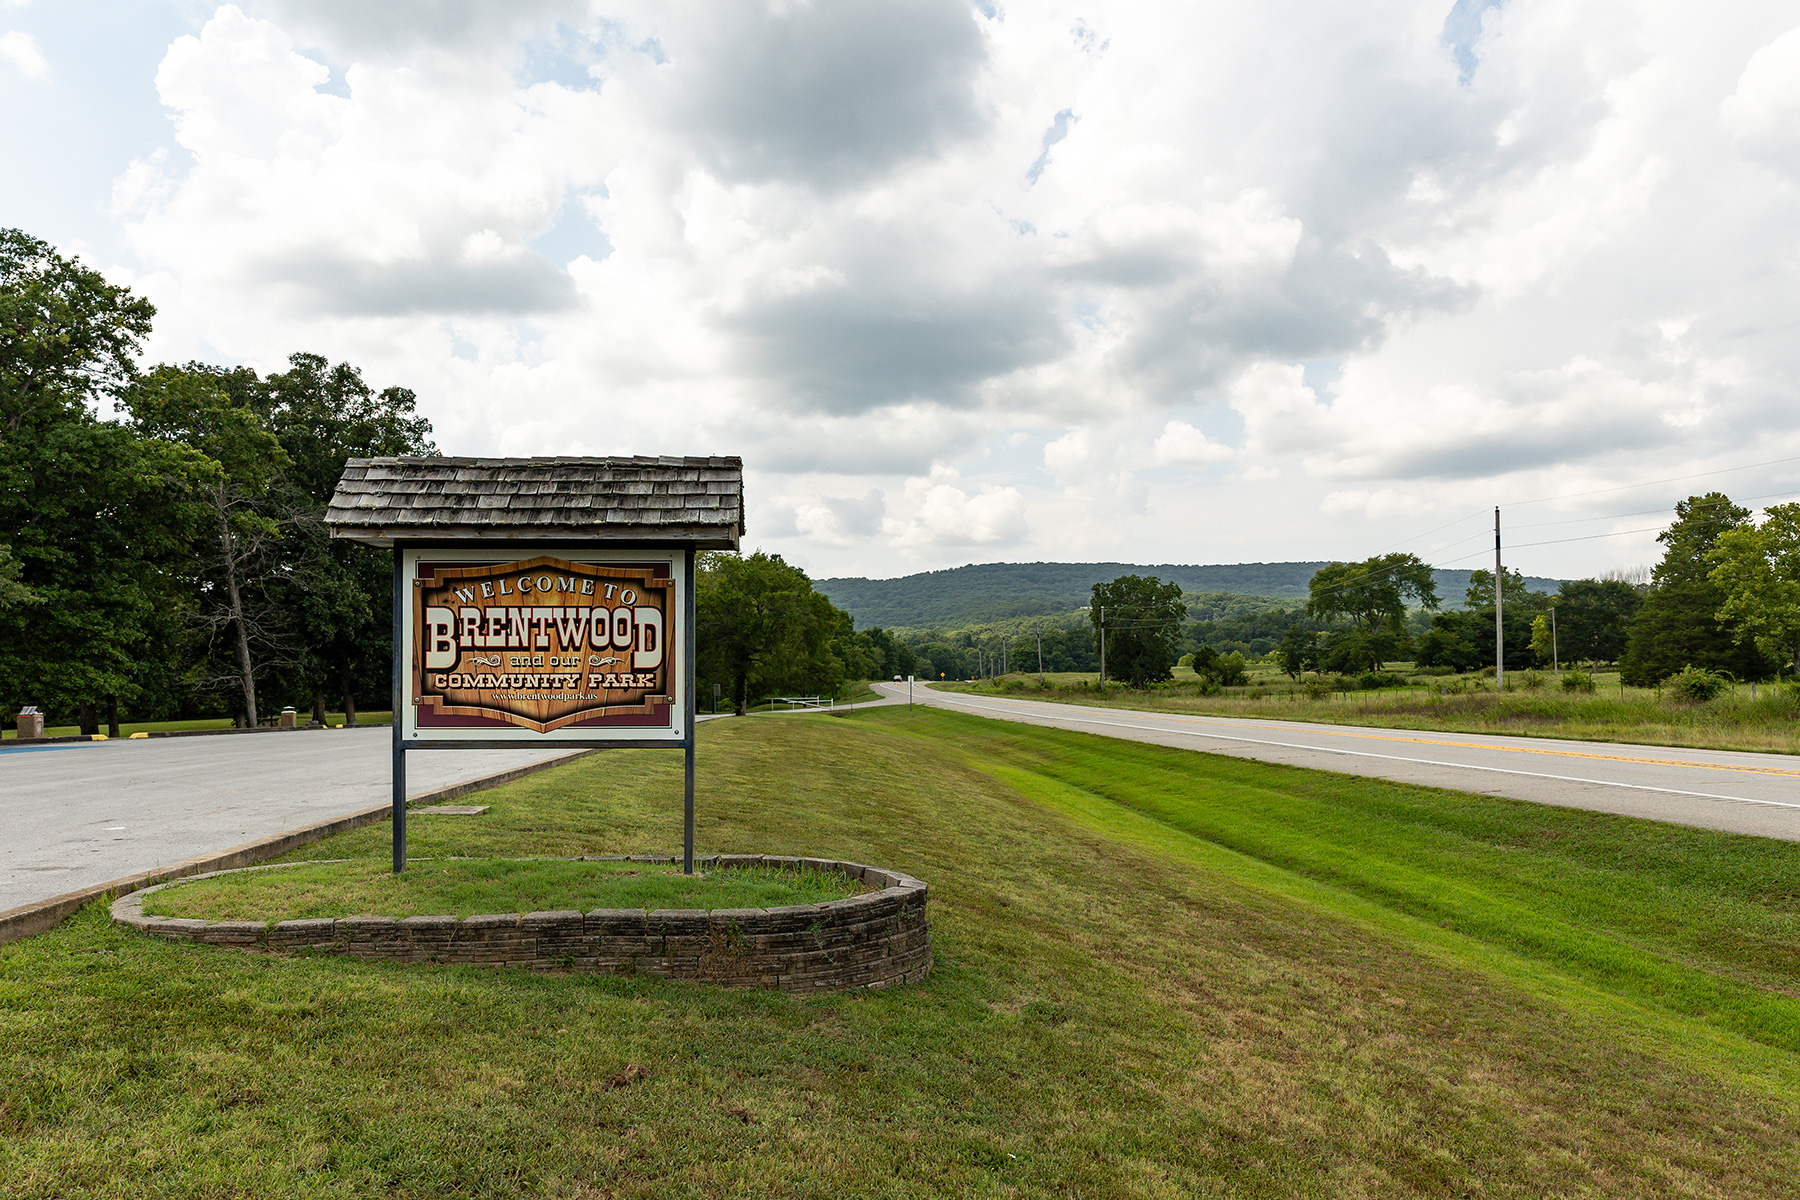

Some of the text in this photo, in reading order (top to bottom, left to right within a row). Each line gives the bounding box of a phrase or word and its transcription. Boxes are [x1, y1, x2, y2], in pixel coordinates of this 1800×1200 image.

[455, 576, 637, 606] WELCOME TO
[425, 606, 663, 669] BRENTWOOD
[510, 655, 580, 667] and our
[435, 673, 655, 688] COMMUNITY PARK
[491, 691, 598, 702] www.brentwoodpark.us
